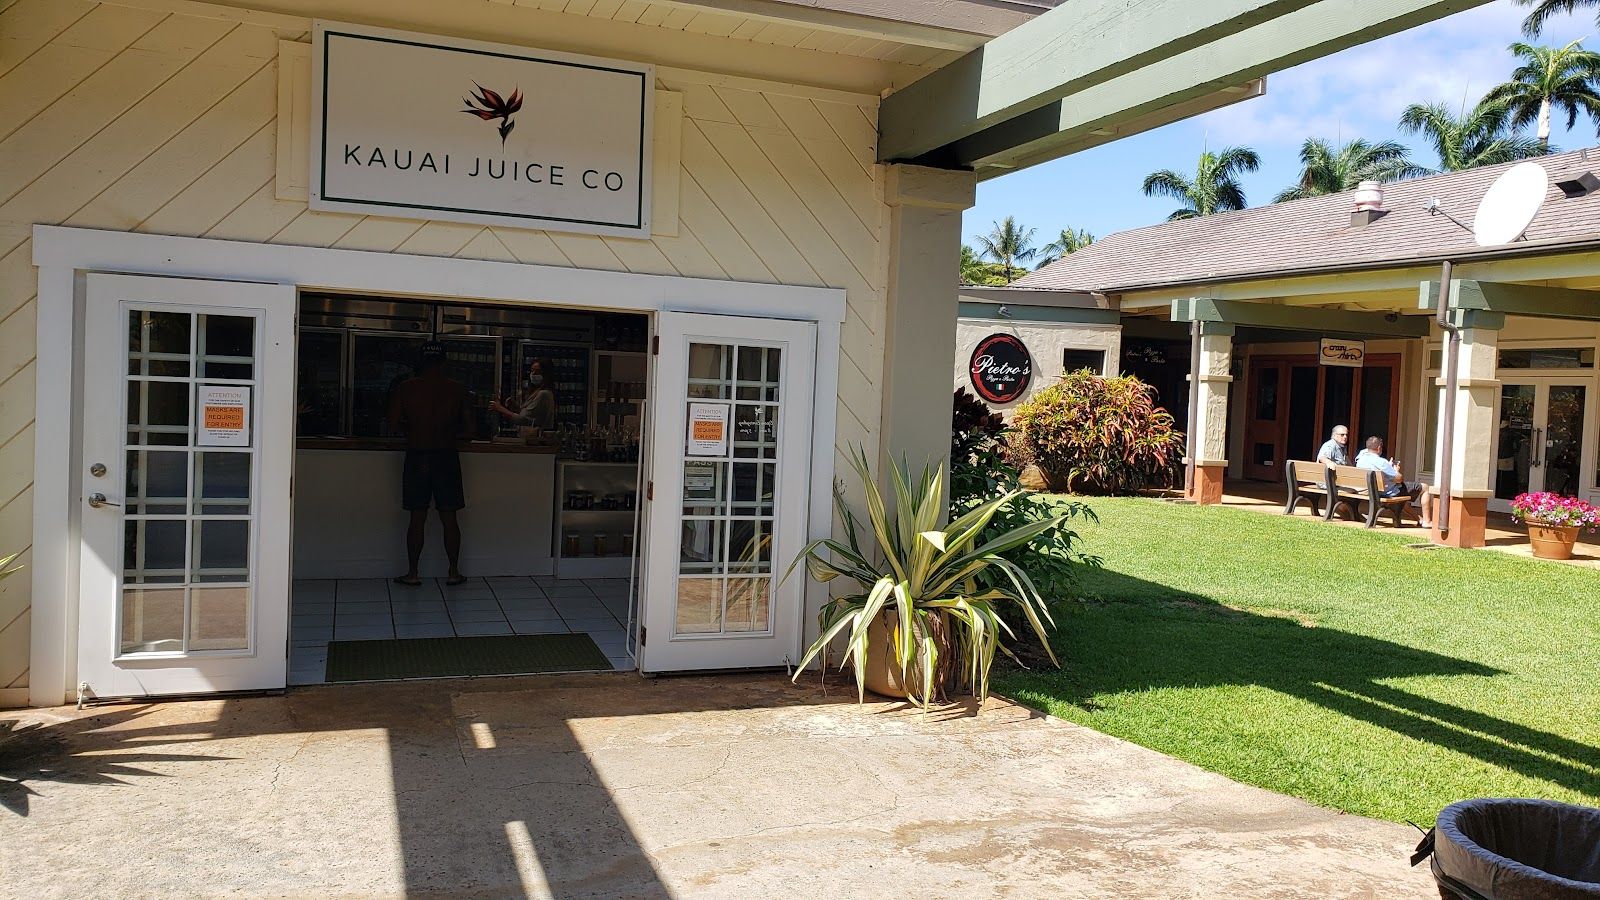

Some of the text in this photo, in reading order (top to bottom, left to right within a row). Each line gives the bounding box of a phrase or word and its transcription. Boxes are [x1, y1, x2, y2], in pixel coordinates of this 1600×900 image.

[344, 144, 623, 191] KAUAI JUICE CO
[971, 354, 1031, 375] Pietro's
